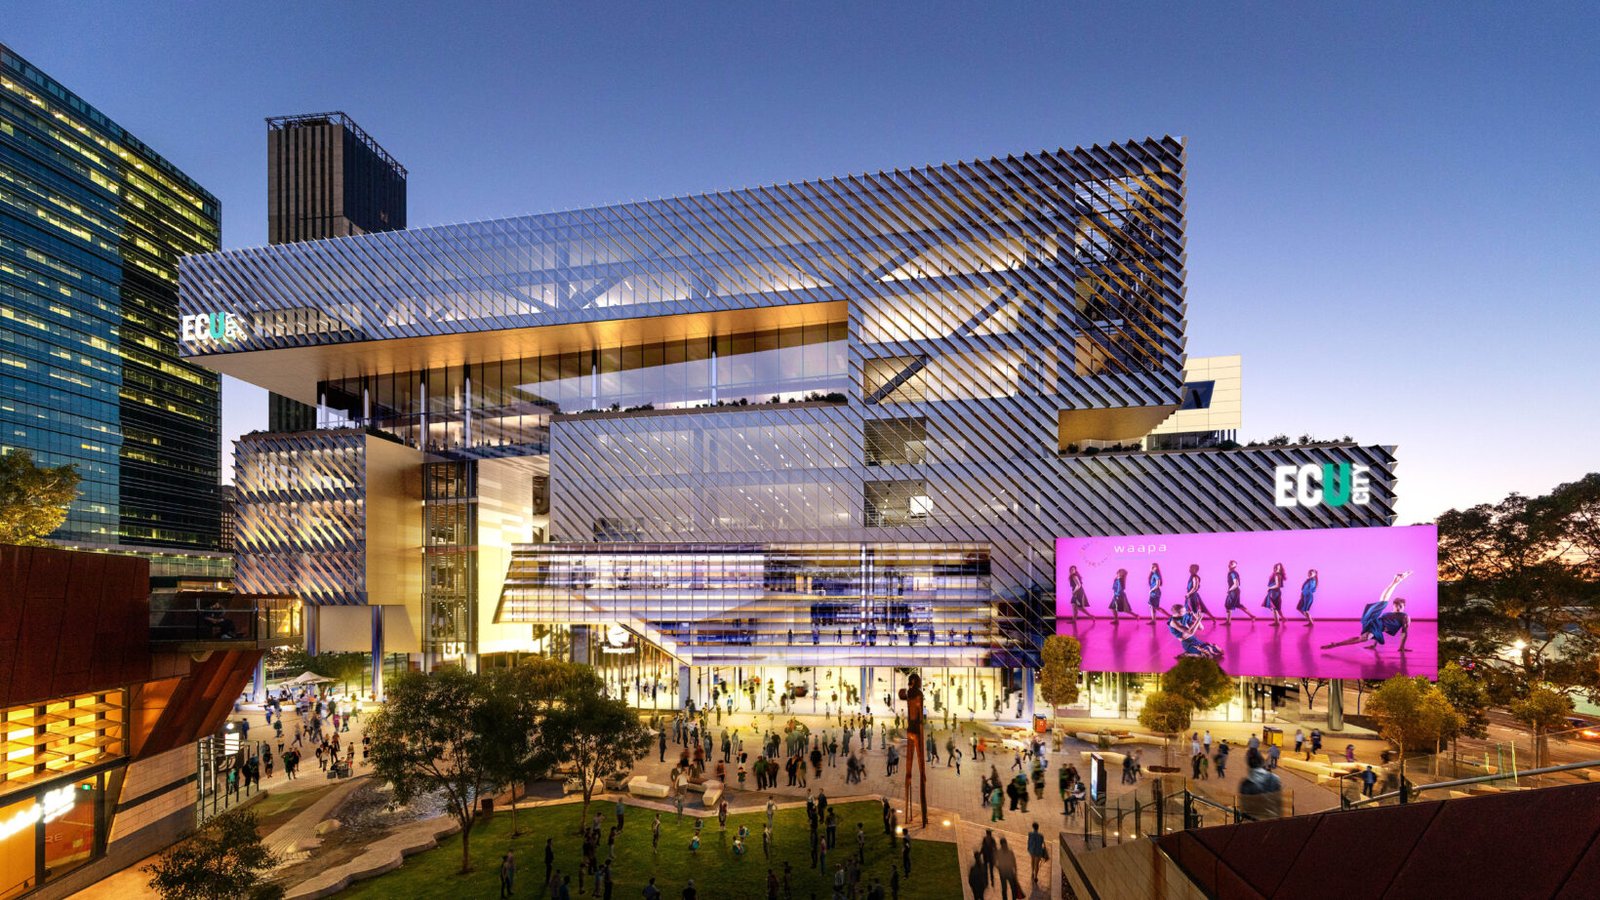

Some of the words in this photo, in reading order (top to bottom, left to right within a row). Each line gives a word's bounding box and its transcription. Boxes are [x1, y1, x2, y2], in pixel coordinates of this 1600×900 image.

[182, 312, 225, 341] ECU
[1275, 463, 1350, 507] ECU
[1352, 463, 1370, 505] CITY
[1114, 543, 1168, 555] waapa
